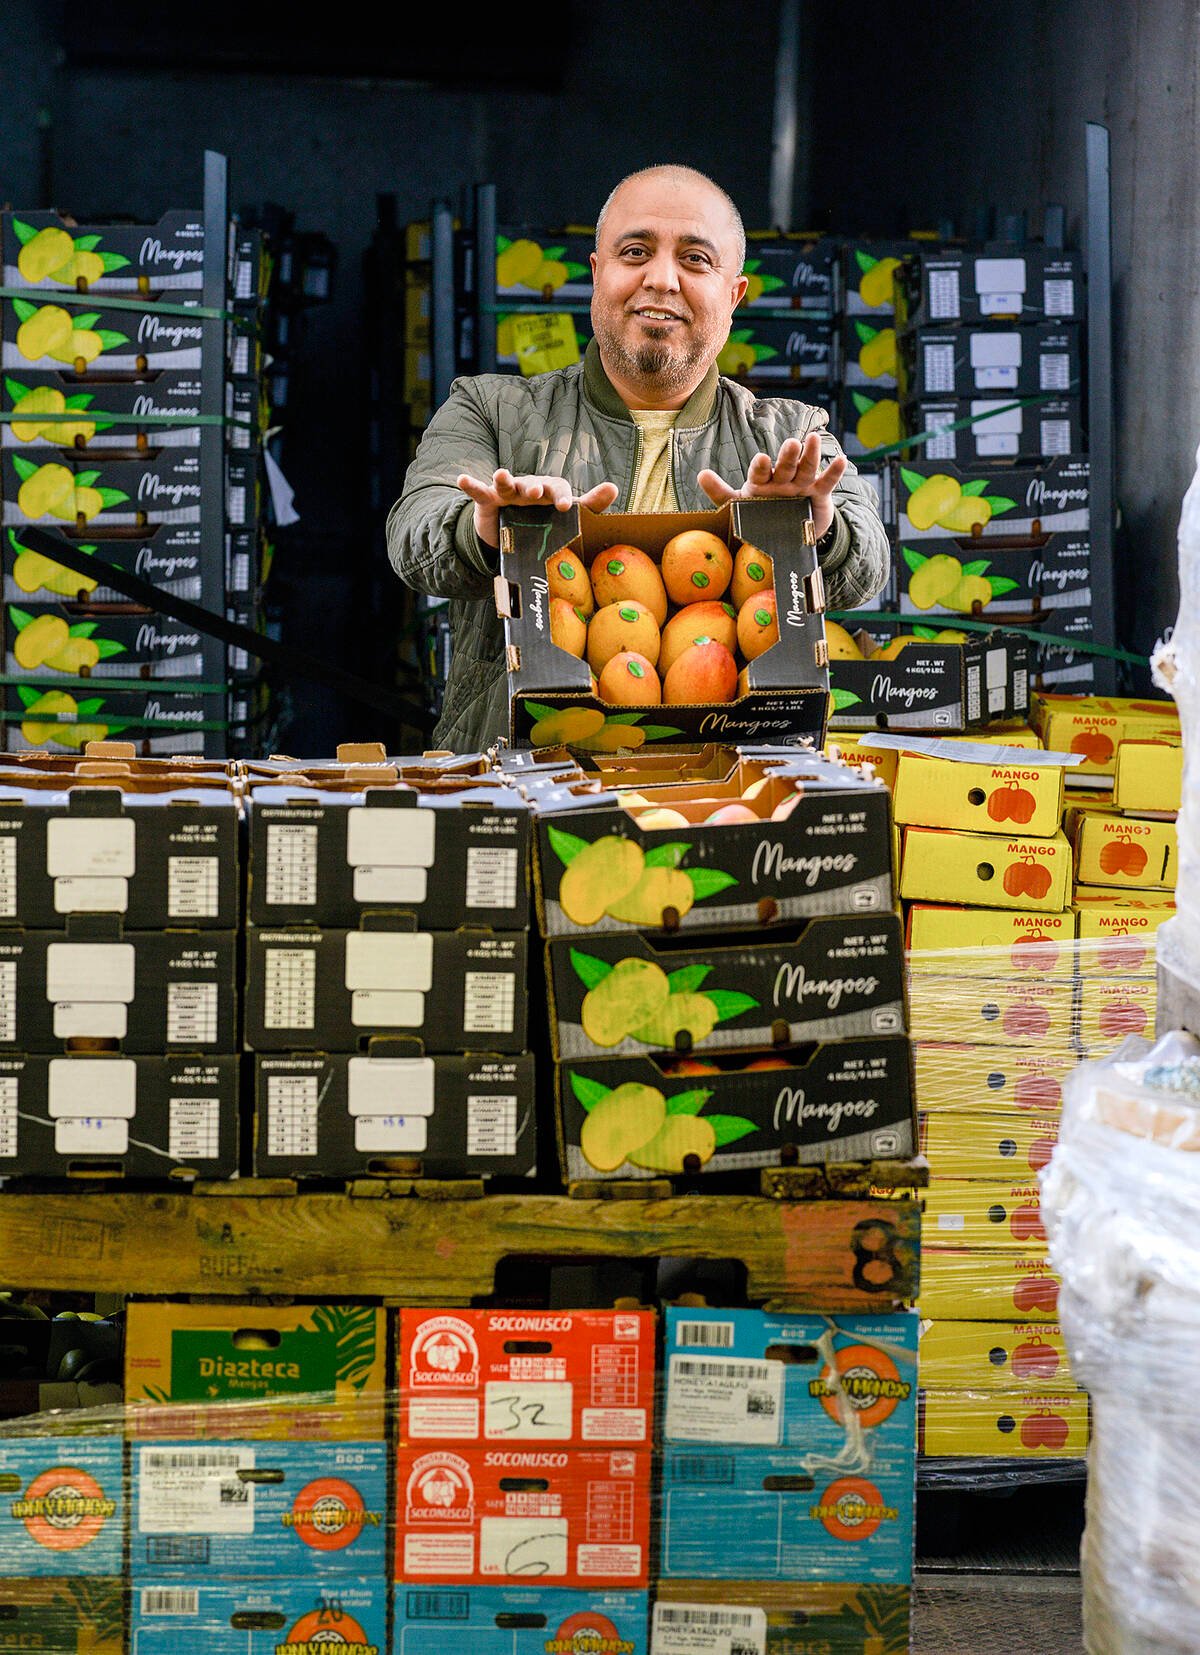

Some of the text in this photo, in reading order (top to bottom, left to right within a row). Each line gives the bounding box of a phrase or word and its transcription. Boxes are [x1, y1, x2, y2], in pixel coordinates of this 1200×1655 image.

[139, 238, 203, 270] Mangoes
[138, 314, 202, 346] Mangoes
[138, 473, 200, 504] Mangoes
[1026, 479, 1089, 509] Mangoes
[530, 576, 548, 631] Mangoes
[786, 571, 805, 627] Mangoes
[136, 624, 200, 654] Mangoes
[870, 674, 938, 708] Mangoes
[699, 713, 792, 735] Mangoes
[1072, 716, 1117, 726] MANGO
[840, 752, 883, 765] MANGO
[991, 769, 1040, 781] MANGO
[1103, 824, 1151, 835] MANGO
[1007, 844, 1056, 856] MANGO
[751, 840, 858, 887] Mangoes
[1013, 917, 1062, 927] MANGO
[1099, 917, 1148, 927] MANGO
[773, 962, 880, 1010] Mangoes
[773, 1087, 880, 1132] Mangoes
[1010, 1187, 1040, 1197] MAN
[488, 1316, 572, 1332] SOCONUSCO
[1013, 1326, 1061, 1335] MANGO
[199, 1356, 300, 1379] Diazteca
[415, 1372, 474, 1383] SOCONUSCO
[1022, 1396, 1071, 1407] MANGO
[490, 1396, 562, 1431] 32
[484, 1453, 568, 1467] SOCONUSCO
[411, 1508, 470, 1518] SOCONUSCO
